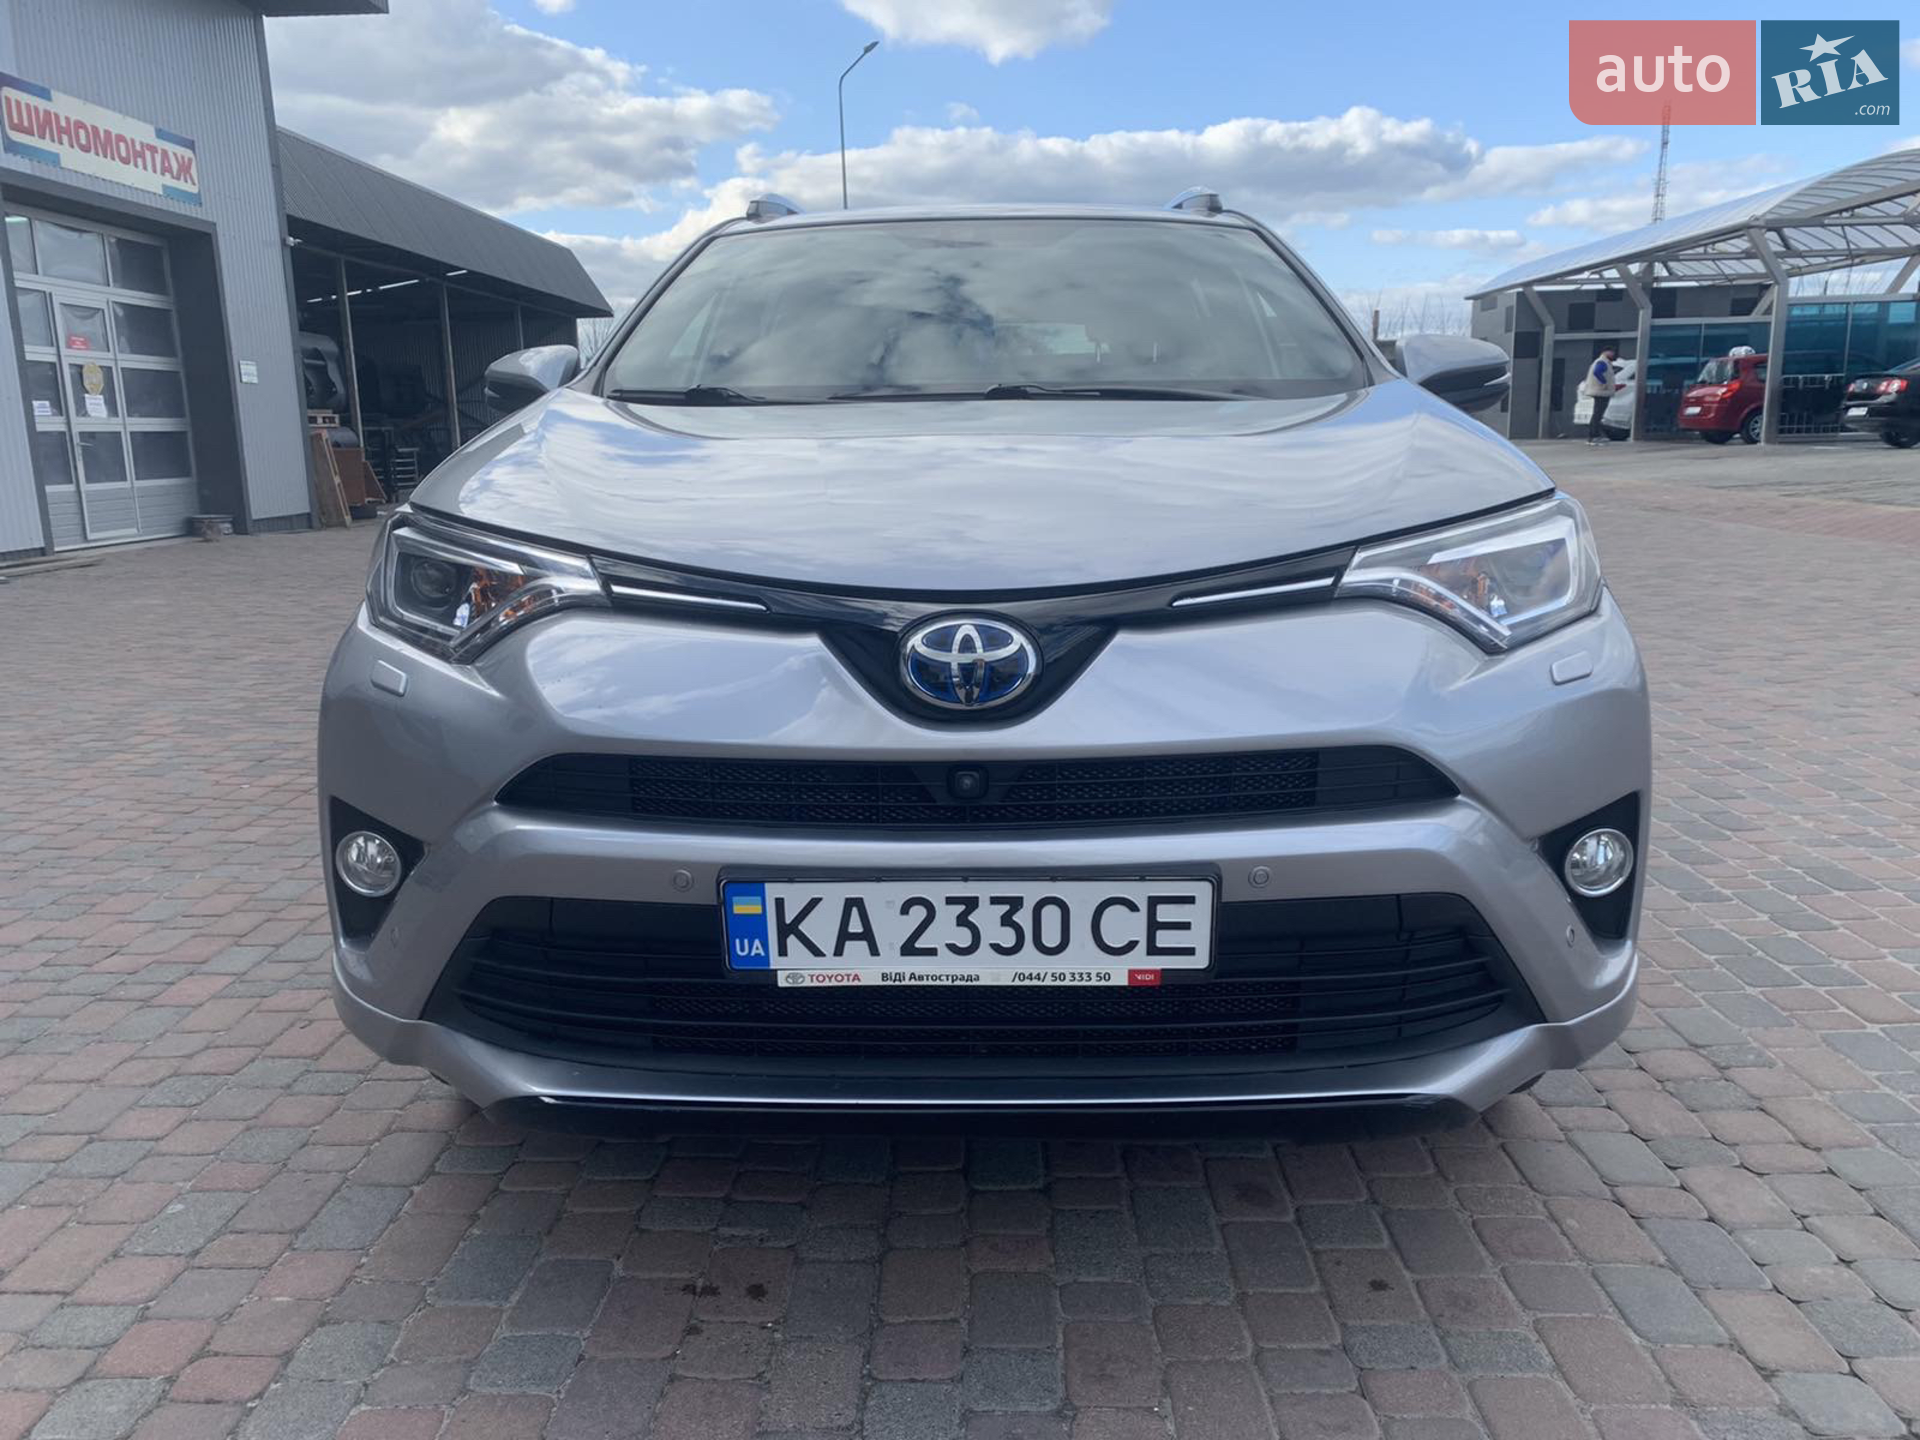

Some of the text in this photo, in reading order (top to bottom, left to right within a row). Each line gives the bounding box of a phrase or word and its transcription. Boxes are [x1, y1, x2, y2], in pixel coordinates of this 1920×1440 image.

[4, 94, 197, 187] ШИНОМОНТАЖ
[774, 895, 1197, 958] KA 2330 CE
[734, 938, 765, 957] UA
[808, 973, 861, 983] TOYOTA
[908, 972, 981, 984] Автострада
[1050, 972, 1067, 983] 50
[1068, 972, 1093, 983] 333
[1095, 972, 1112, 983] 50
